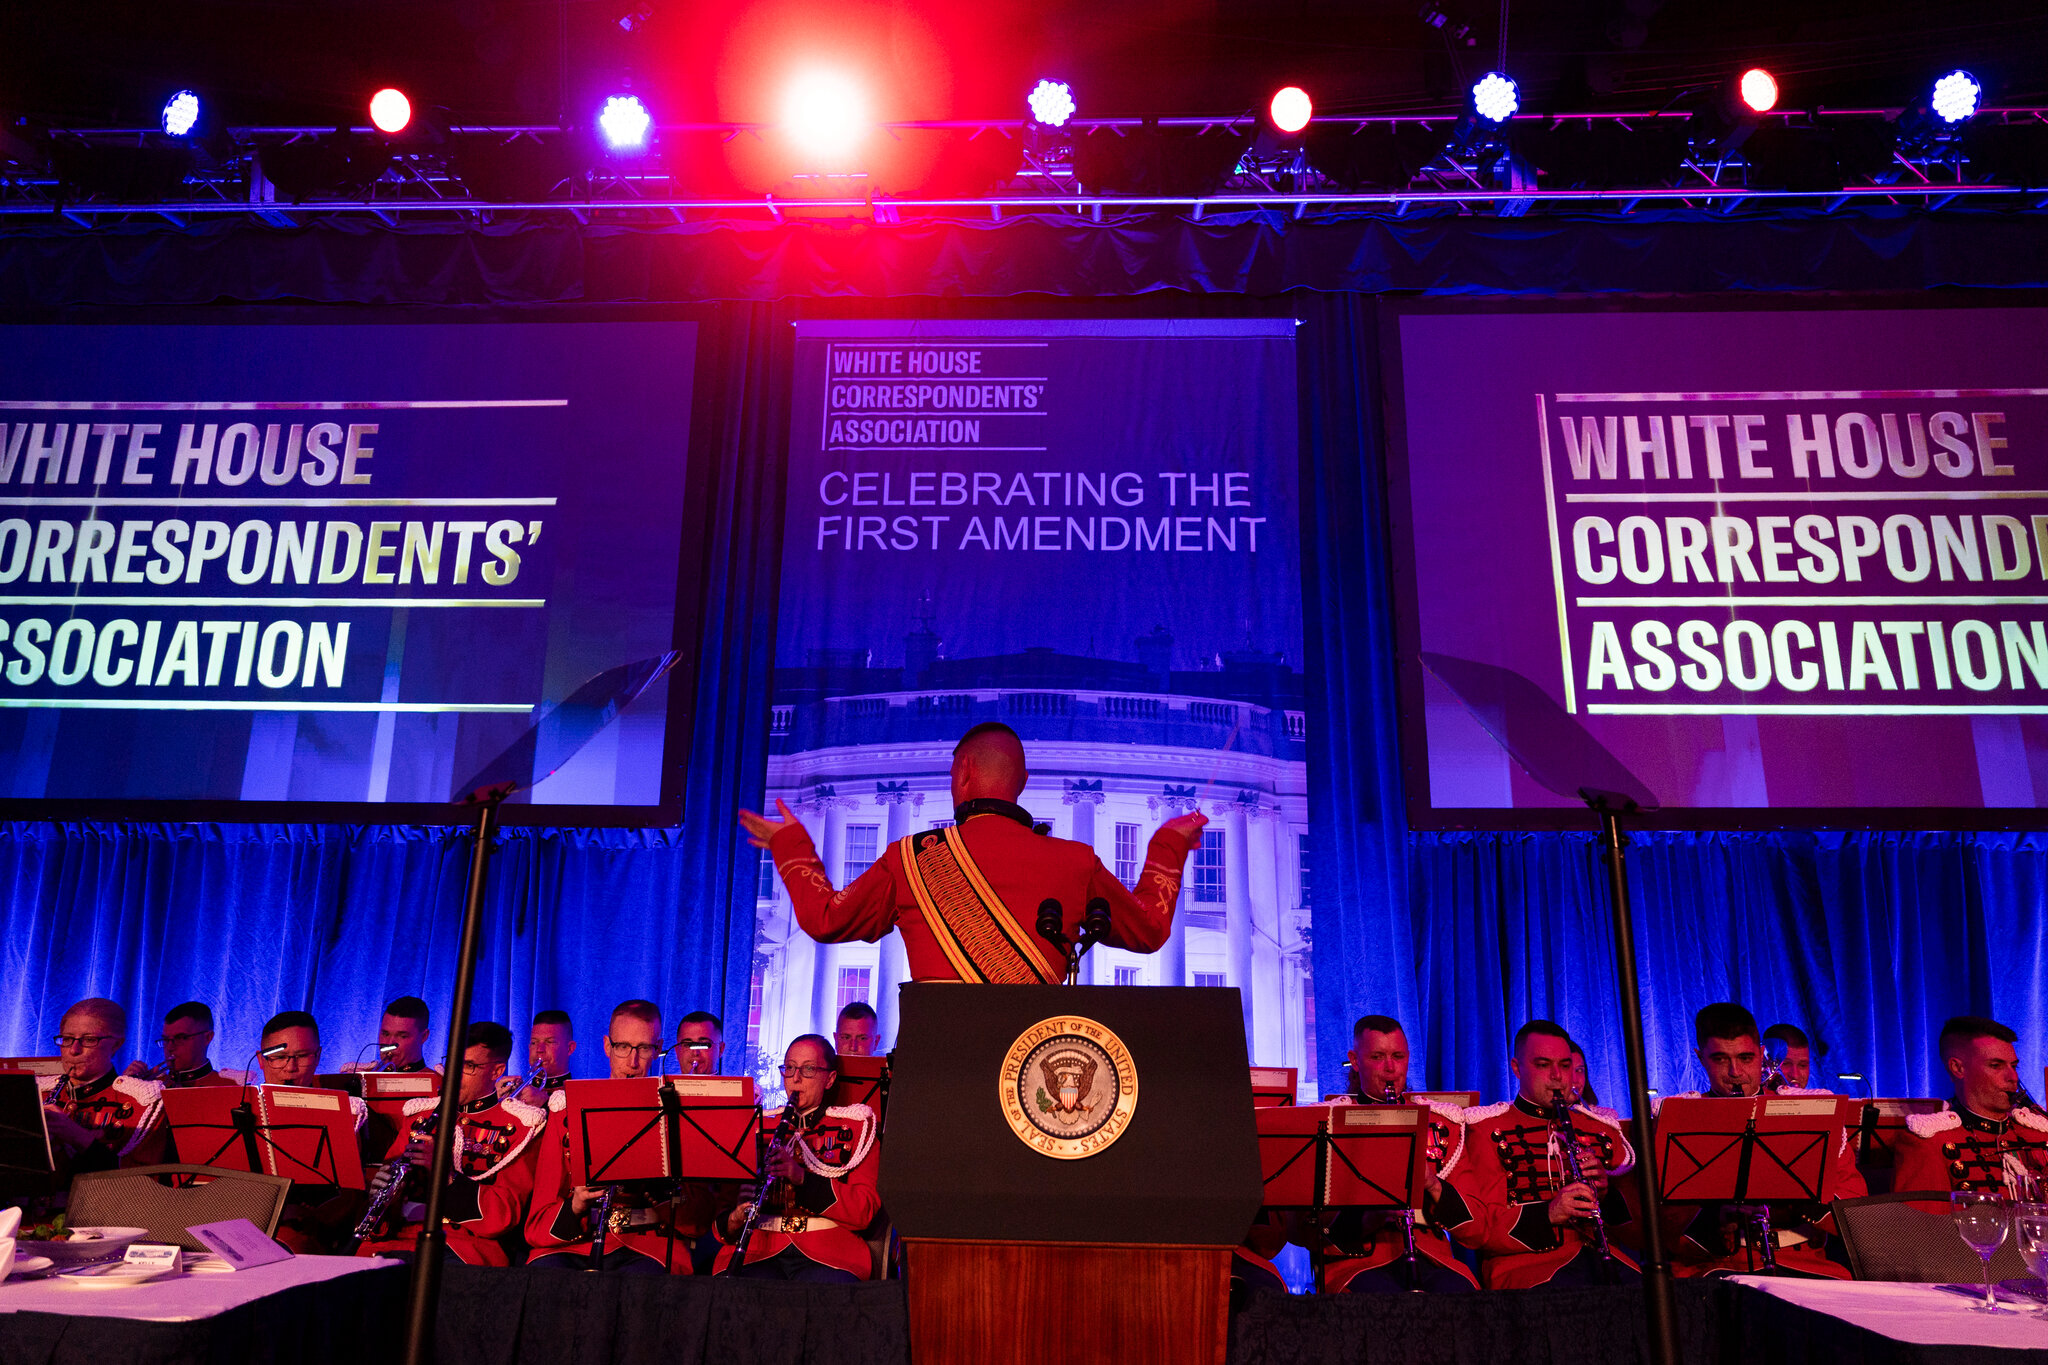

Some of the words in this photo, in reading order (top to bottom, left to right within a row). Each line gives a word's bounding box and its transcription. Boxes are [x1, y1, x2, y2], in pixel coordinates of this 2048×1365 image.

[835, 352, 902, 373] WHITE
[909, 351, 981, 373] HOUSE
[832, 385, 1043, 408] CORRESPONDENTS’
[830, 420, 979, 443] ASSOCIATION
[1560, 415, 1773, 480] WHITE
[1787, 412, 2014, 479] HOUSE
[171, 423, 379, 485] HOUSE
[820, 472, 1143, 506] CELEBRATING
[1159, 473, 1250, 506] THE
[818, 516, 949, 550] FIRST
[959, 517, 1266, 552] AMENDMENT
[0, 619, 351, 688] SOCIATION
[1587, 620, 2048, 691] ASSOCIATION
[1070, 1023, 1082, 1032] OF
[1085, 1026, 1102, 1039] THE
[1004, 1021, 1067, 1082] PRESIDENT
[1104, 1039, 1134, 1096] UNITED
[1006, 1087, 1015, 1107] THE
[1010, 1109, 1021, 1121] OF
[1080, 1108, 1128, 1152] STATES
[1021, 1119, 1056, 1151] SEAL
